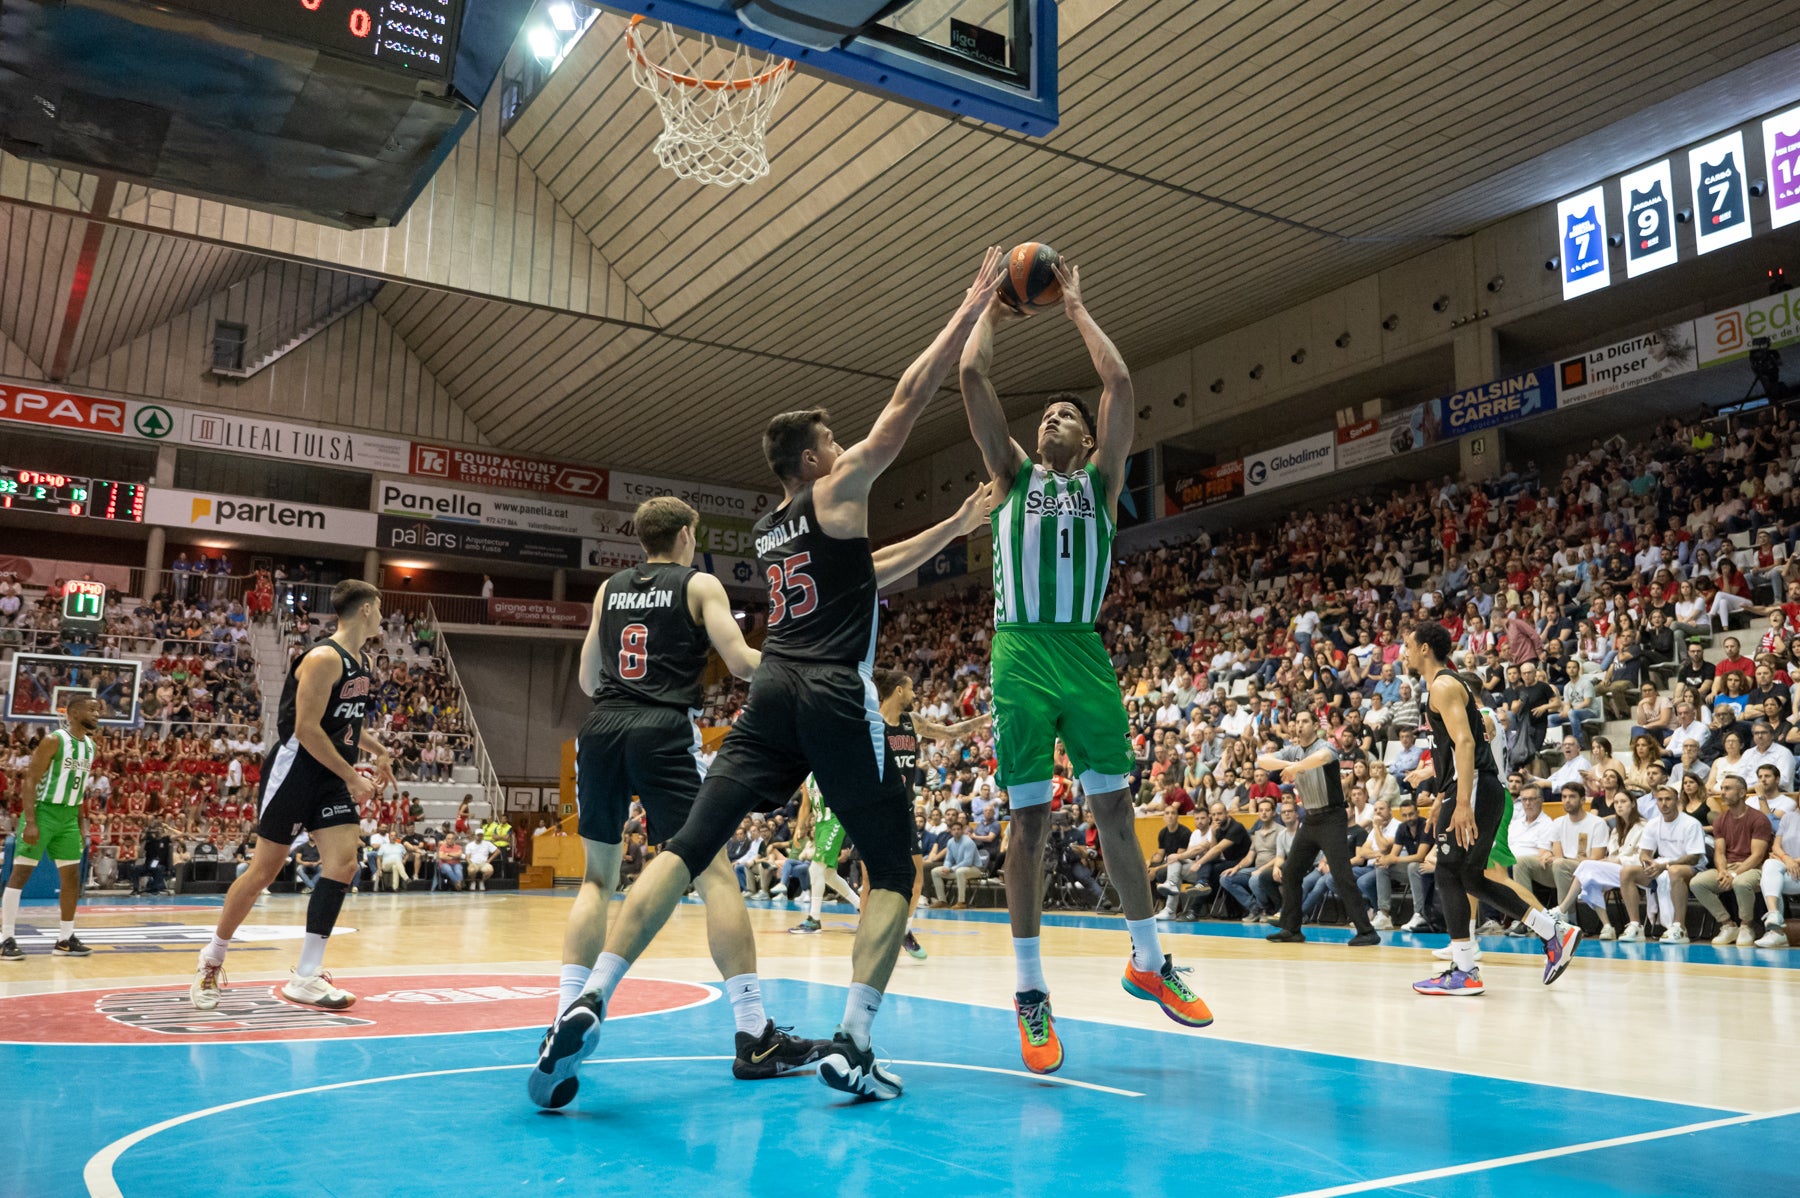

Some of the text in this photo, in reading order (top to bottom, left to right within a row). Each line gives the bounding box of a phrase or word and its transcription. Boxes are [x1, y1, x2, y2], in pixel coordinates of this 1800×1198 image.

[1708, 181, 1730, 212] 7
[1637, 209, 1659, 237] 9
[1575, 234, 1590, 261] 7
[1589, 334, 1660, 364] La DIGITAL
[1591, 357, 1648, 384] impser
[1449, 372, 1539, 411] CALSINA
[0, 389, 121, 427] PAR
[226, 422, 283, 453] LLEAL
[292, 431, 354, 463] TULSÀ
[454, 451, 557, 474] EQUIPACIONS
[1270, 445, 1331, 471] Globalimar
[19, 470, 65, 487] 07:40
[460, 463, 550, 484] ESPORTIVES
[36, 486, 46, 499] 2
[72, 488, 87, 501] 19
[384, 486, 568, 519] Panella www.panella.cat
[70, 503, 81, 515] 0
[215, 500, 326, 530] parlem
[755, 515, 809, 559] SOROLLA
[1060, 528, 1070, 558] 1
[77, 593, 99, 613] 17
[608, 587, 673, 611] PRKAČIN
[766, 551, 819, 628] 35
[495, 603, 526, 613] girona
[619, 623, 648, 680] 8
[72, 776, 81, 790] 8
